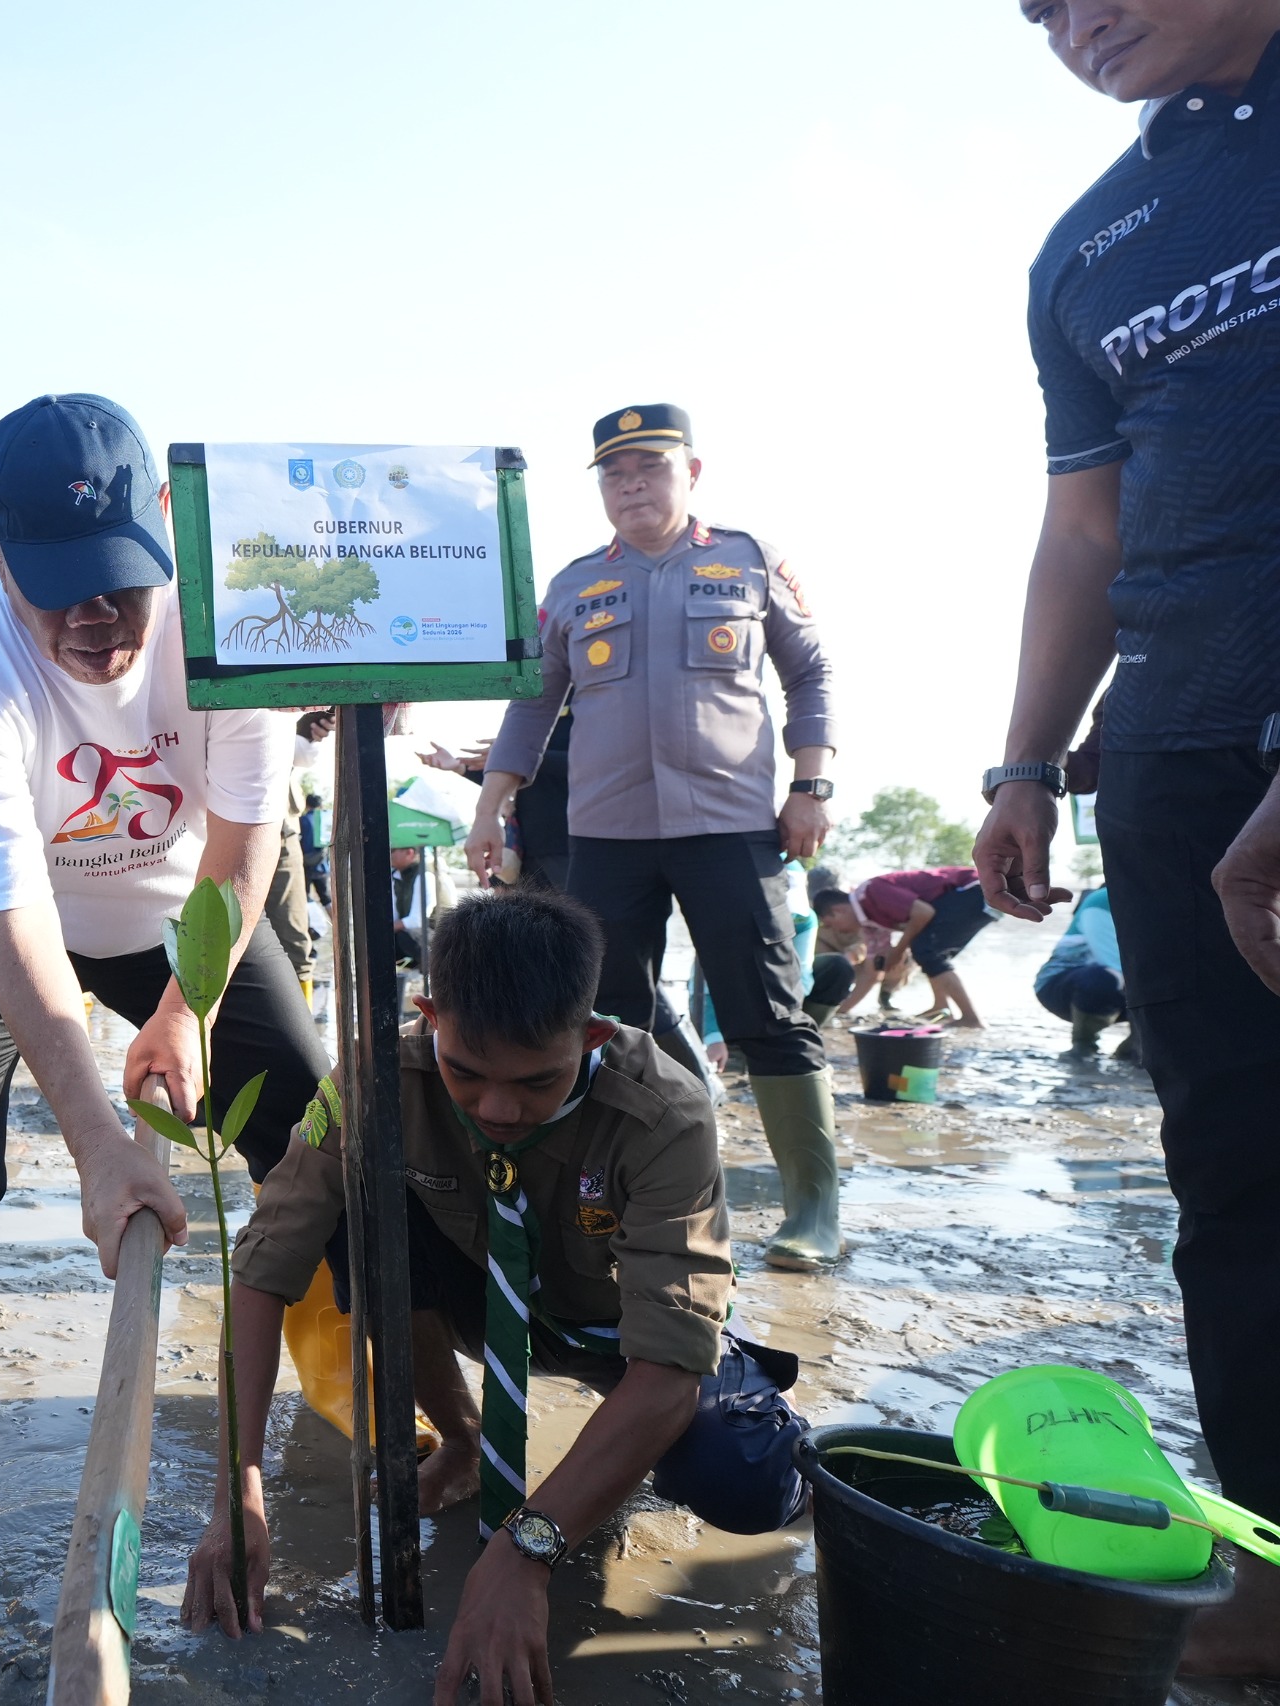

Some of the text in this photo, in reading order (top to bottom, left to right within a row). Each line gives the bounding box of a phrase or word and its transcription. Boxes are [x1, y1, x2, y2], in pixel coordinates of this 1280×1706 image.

[1078, 197, 1159, 267] FERDY
[1165, 343, 1191, 365] BIRO
[313, 520, 404, 534] GUBERNUR
[231, 543, 487, 559] KEPULAUAN BANGKA BELITUNG
[689, 583, 746, 599] POLRI
[574, 592, 628, 617] DEDI
[151, 731, 180, 750] TH
[54, 853, 124, 869] Bangka
[83, 855, 168, 878] #UntukRakyat
[1026, 1407, 1130, 1435] DLHK
